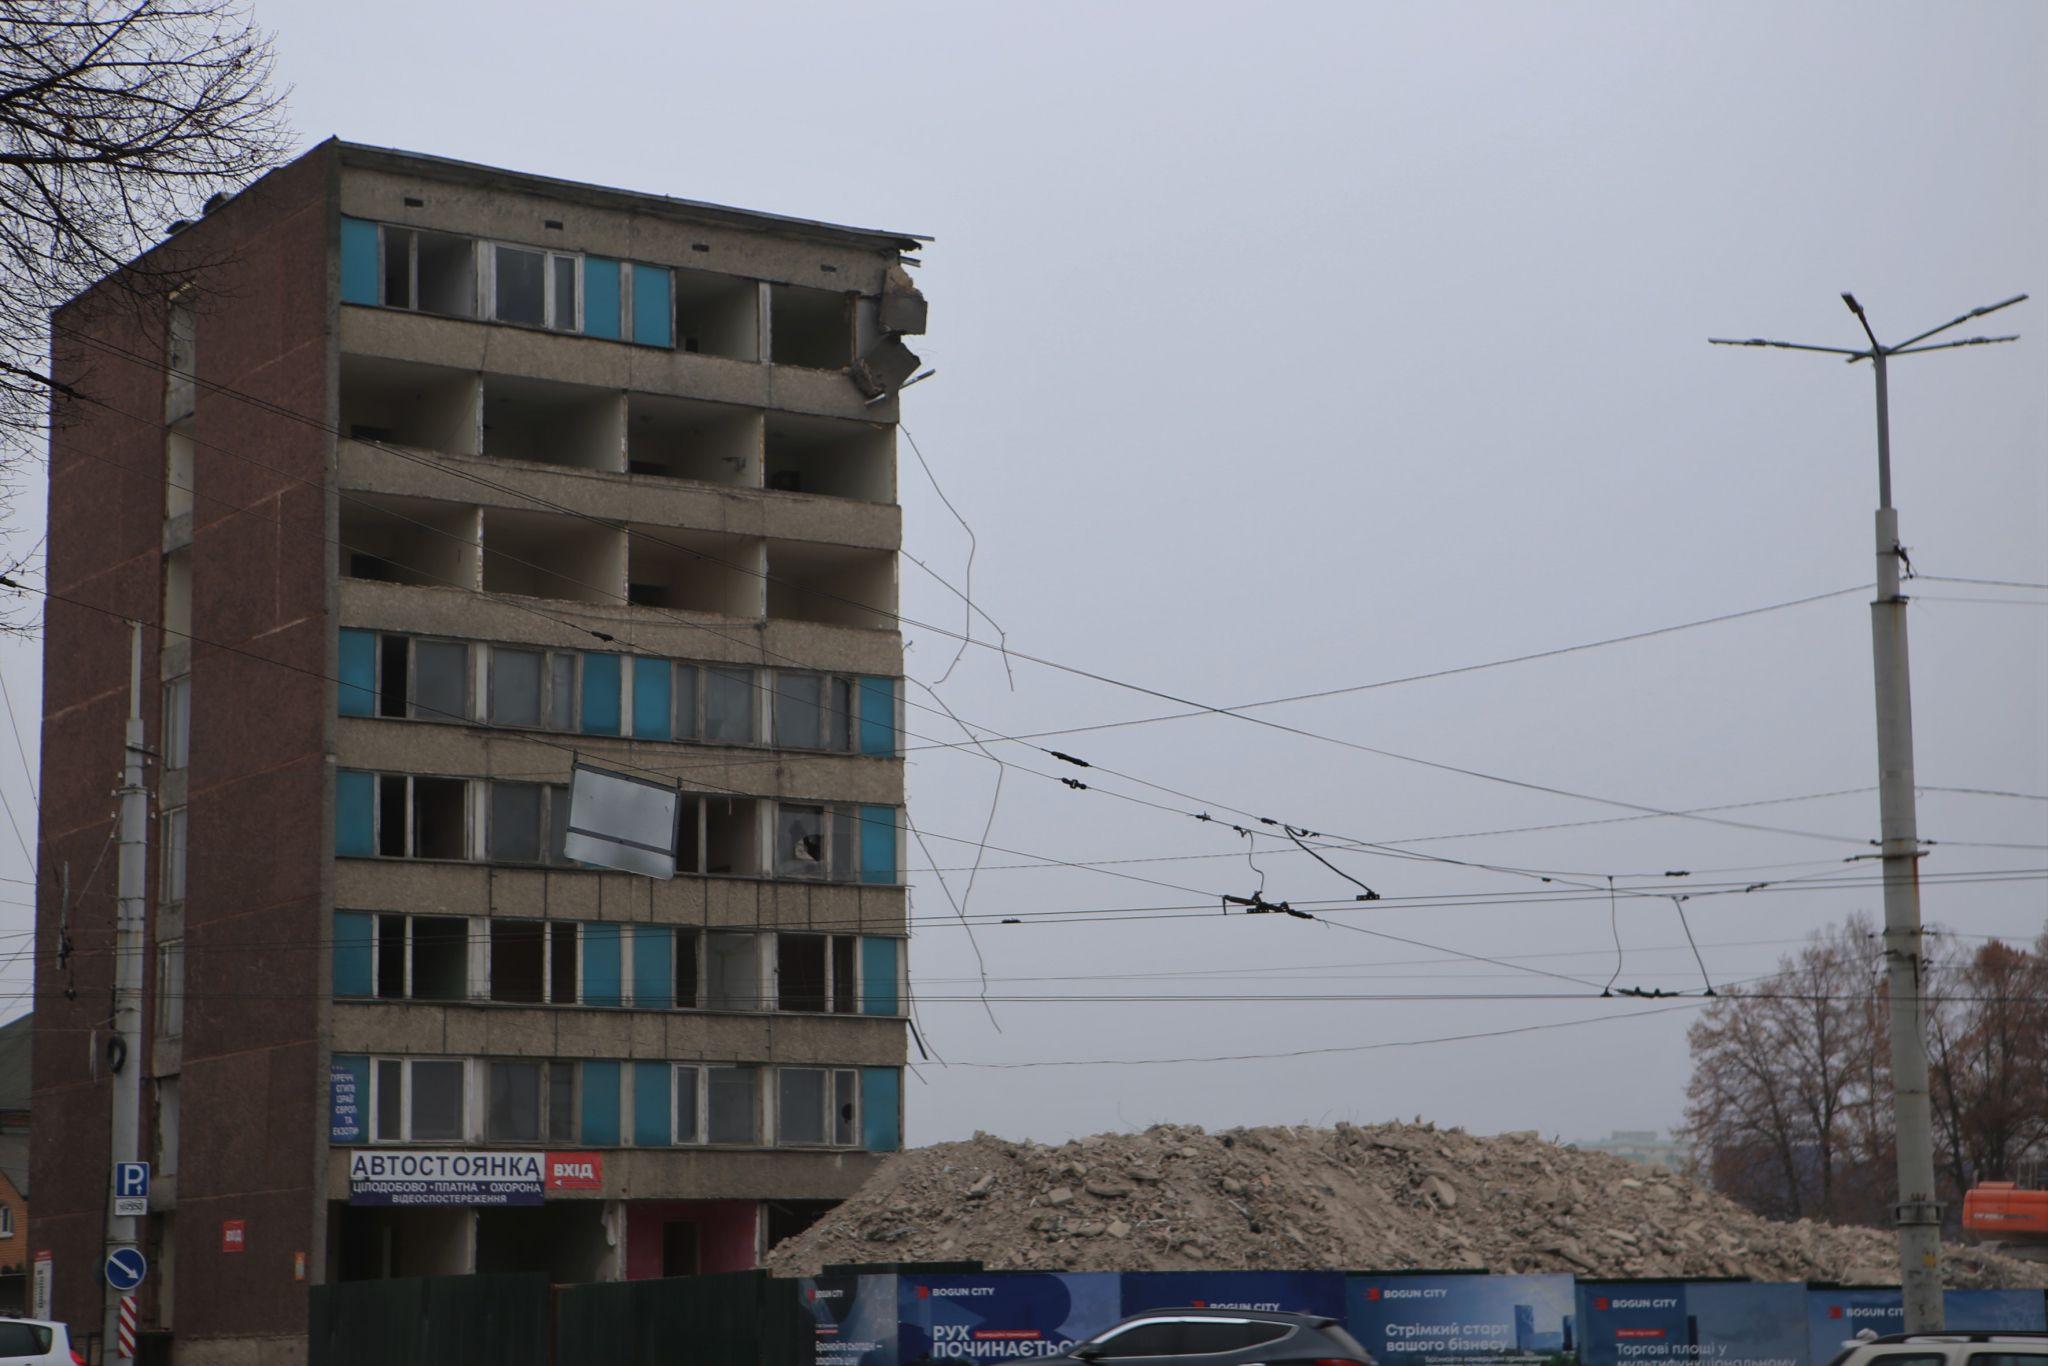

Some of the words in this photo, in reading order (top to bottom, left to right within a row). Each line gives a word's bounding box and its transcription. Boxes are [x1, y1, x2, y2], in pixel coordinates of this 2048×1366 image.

[344, 1116, 353, 1125] ТА
[352, 1155, 541, 1177] АВТОСТОЯНКА
[553, 1163, 593, 1179] ВХІД
[124, 1164, 144, 1195] P
[353, 1181, 427, 1193] ЦІЛОДОБОВО
[434, 1181, 478, 1193] ПЛАТНА
[490, 1182, 541, 1193] ОХОРОНА
[392, 1194, 507, 1204] ВІДЕОСПОСТЕРЕЖЕННЯ
[932, 1288, 969, 1296] BOGUN
[971, 1287, 995, 1296] CITY
[1384, 1289, 1421, 1298] BOGUN
[1423, 1289, 1447, 1298] CITY
[1253, 1303, 1280, 1312] CITY
[1612, 1299, 1650, 1308] BOGUN
[1652, 1299, 1677, 1308] CITY
[1847, 1307, 1885, 1317] BOGUN
[933, 1325, 970, 1341] РУХ
[1385, 1322, 1459, 1338] Стрімкий
[1463, 1324, 1509, 1338] старт
[933, 1340, 1083, 1358] ПОЧИНАЄТЬС
[1386, 1339, 1445, 1352] вашого
[1448, 1337, 1508, 1353] бізнесу
[1616, 1342, 1669, 1356] Торгові
[1672, 1342, 1715, 1355] площі
[1718, 1344, 1727, 1355] у
